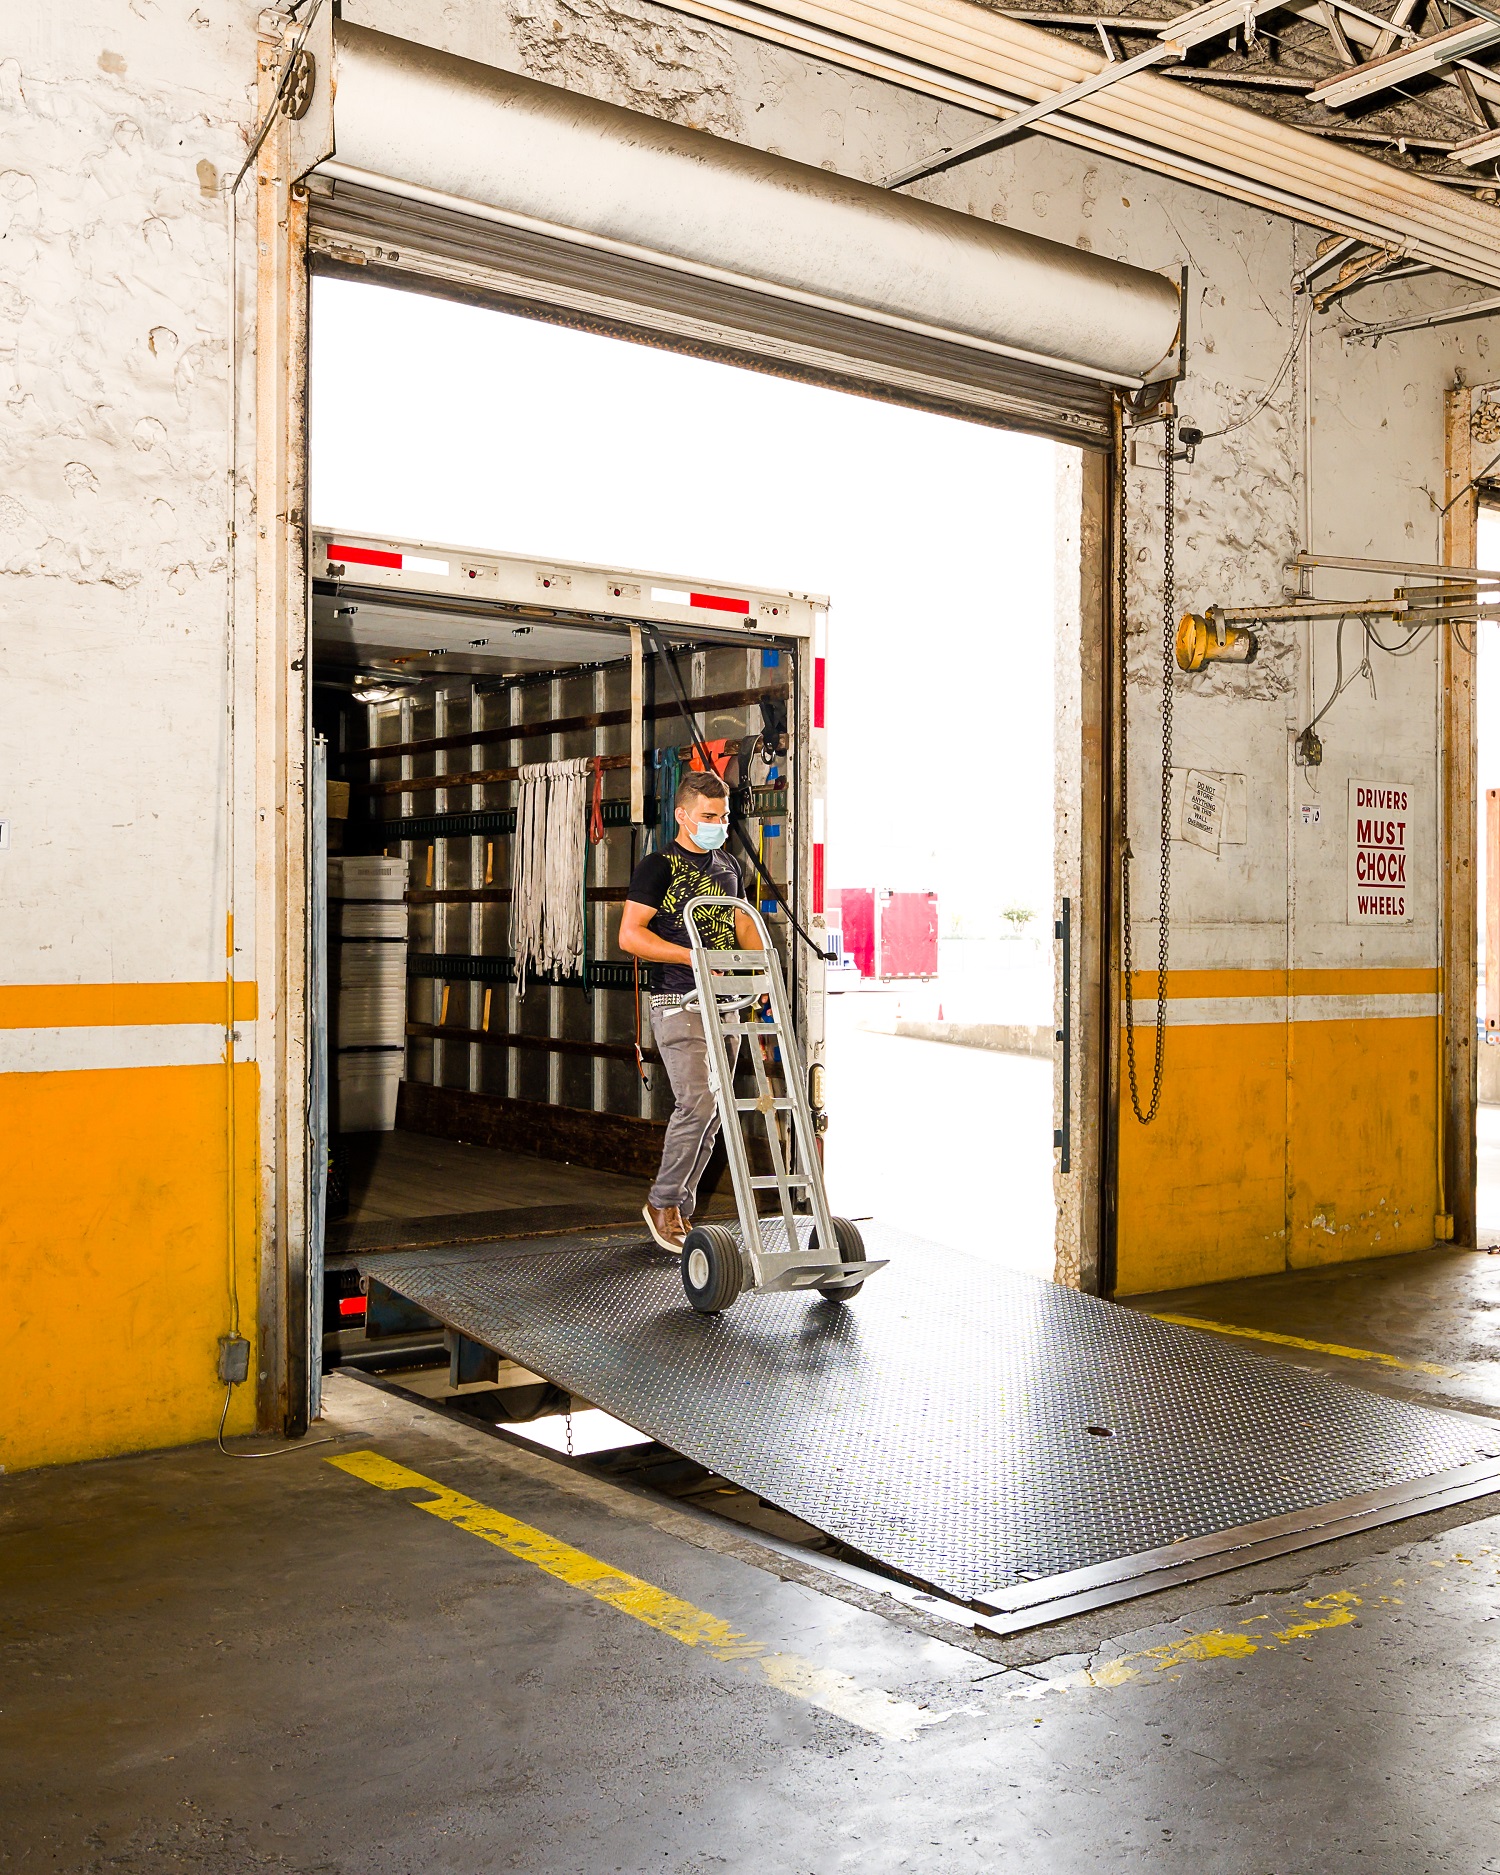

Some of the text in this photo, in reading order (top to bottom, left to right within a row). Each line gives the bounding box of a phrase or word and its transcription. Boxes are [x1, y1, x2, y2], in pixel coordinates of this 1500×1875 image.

[1197, 781, 1216, 793] DO NOT
[1197, 789, 1213, 801] STORE
[1357, 788, 1408, 810] DRIVERS
[1192, 796, 1216, 811] ANYTHING
[1193, 804, 1212, 817] ON THIS
[1187, 817, 1213, 832] OVERNIGHT
[1194, 812, 1207, 823] WALL
[1356, 819, 1406, 845] MUST
[1356, 851, 1406, 882] CHOCK
[1358, 895, 1405, 916] WHEELS
